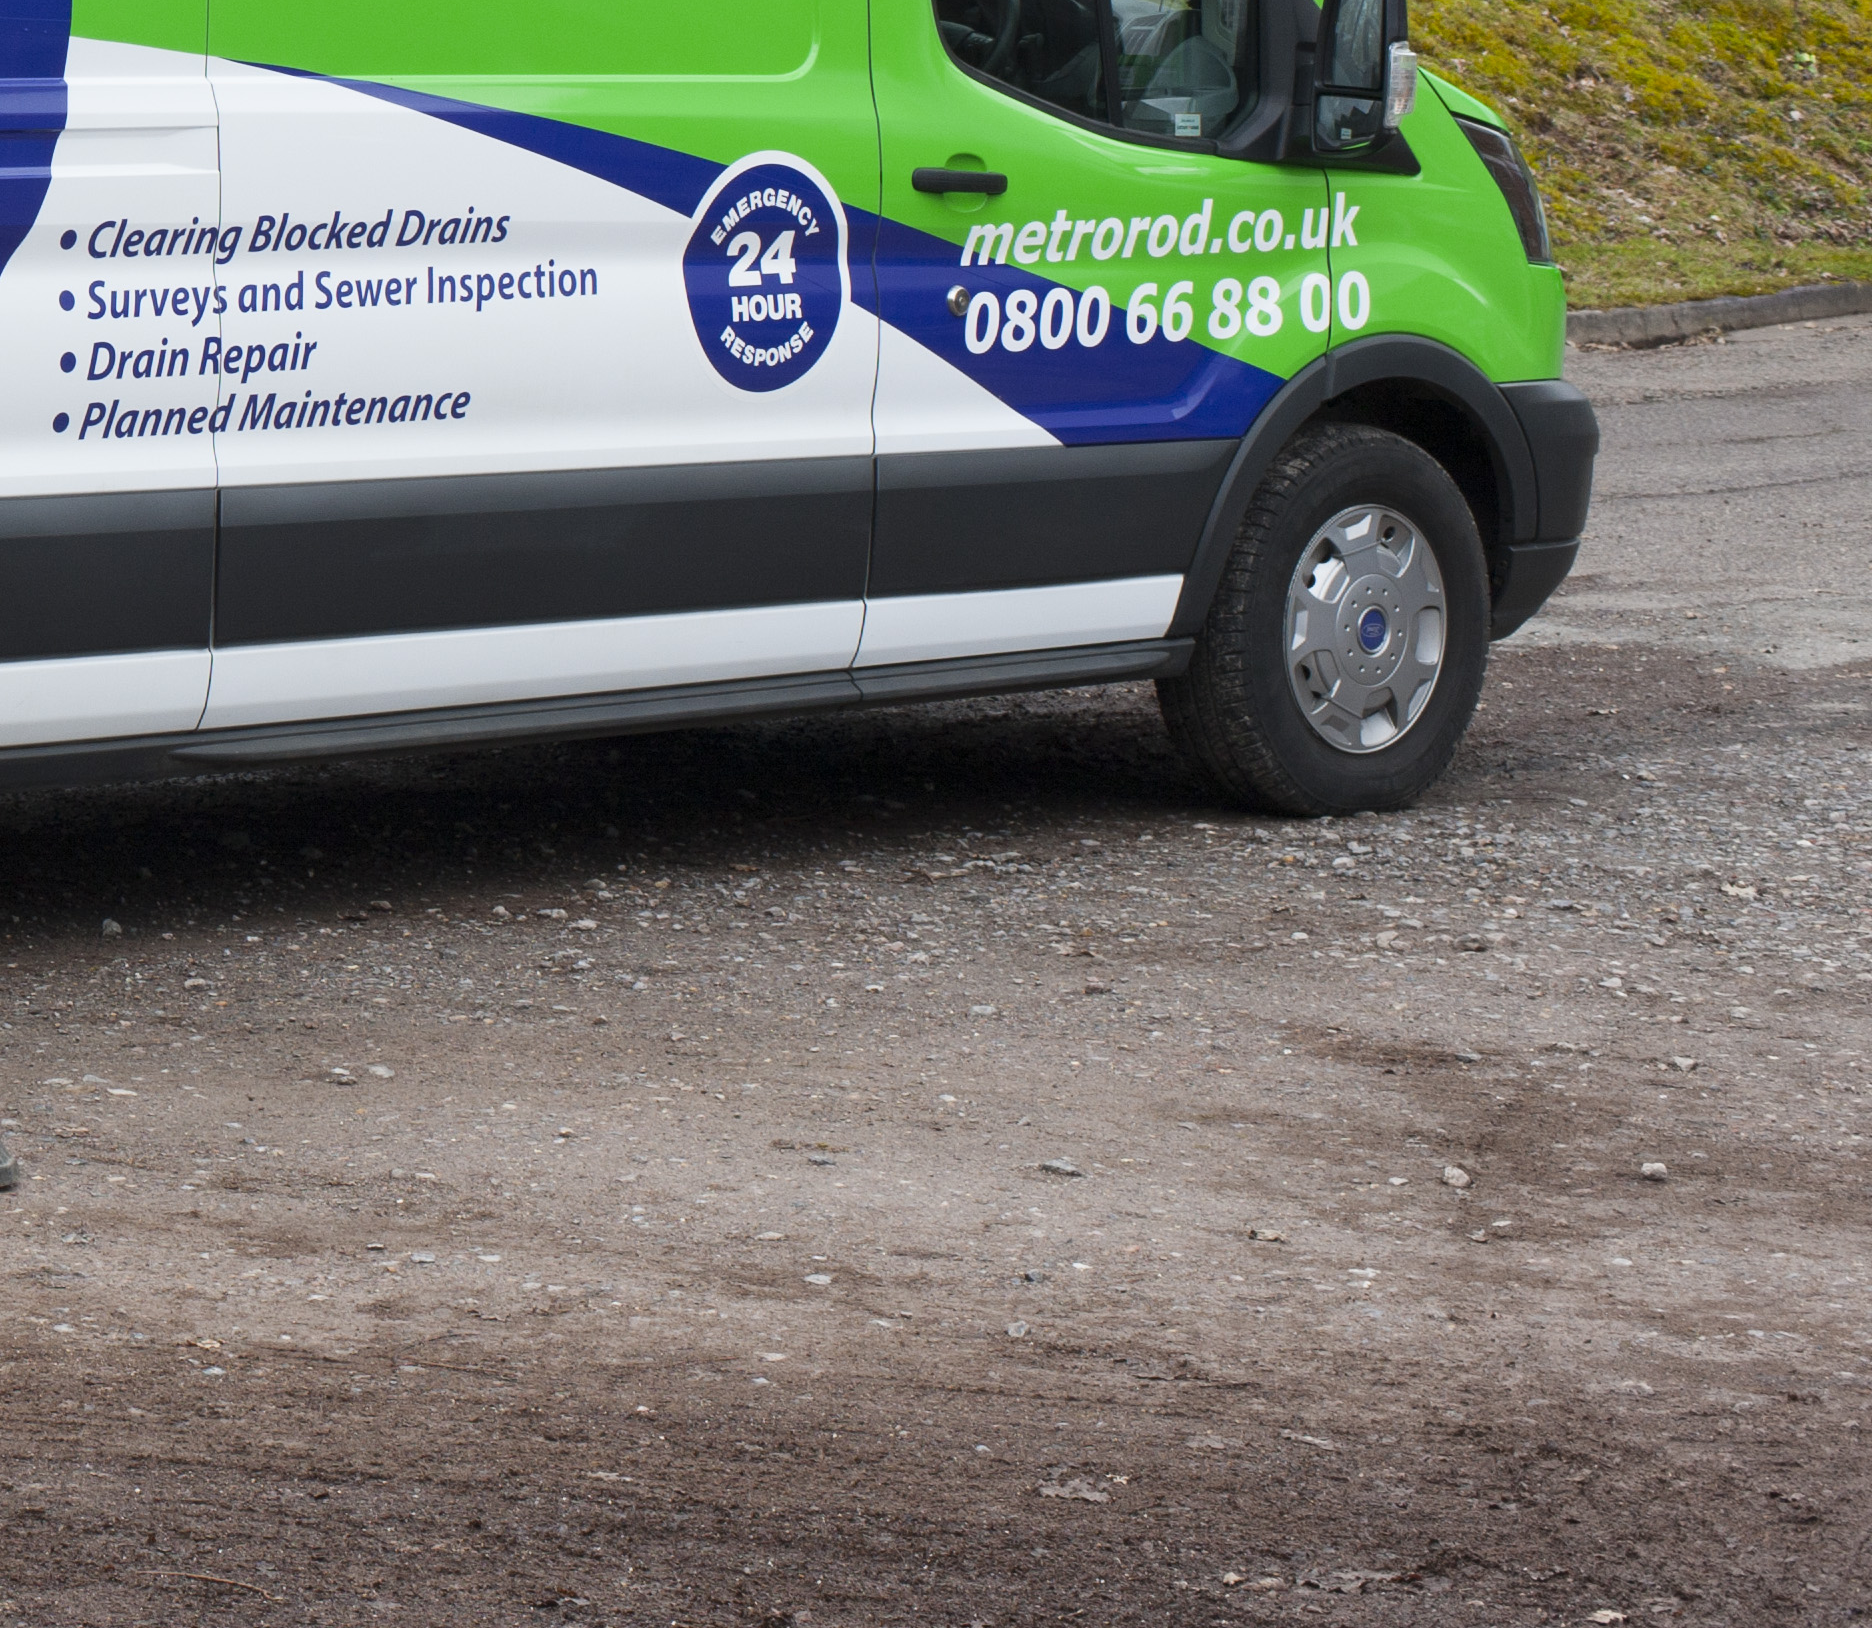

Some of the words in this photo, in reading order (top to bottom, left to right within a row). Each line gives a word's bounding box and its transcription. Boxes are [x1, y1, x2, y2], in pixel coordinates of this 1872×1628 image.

[88, 218, 240, 264] Clearing
[249, 210, 398, 252] Blocked
[396, 206, 510, 246] Drains
[710, 187, 820, 246] EMERGENCY
[960, 191, 1361, 267] metrorod.co.uk
[726, 230, 796, 287] 24
[87, 279, 227, 327] Surveys
[238, 271, 304, 313] and
[314, 270, 417, 310] Sewer
[427, 259, 599, 312] Inspection
[731, 293, 802, 322] HOUR
[964, 285, 1111, 354] 0800
[1125, 280, 1194, 344] 66
[1208, 276, 1283, 340] 88
[1299, 270, 1371, 333] 00
[87, 338, 189, 381] Drain
[199, 331, 317, 383] Repair
[720, 321, 814, 367] RESPONSE
[78, 393, 235, 440] Planned
[237, 389, 470, 433] Maintenance
